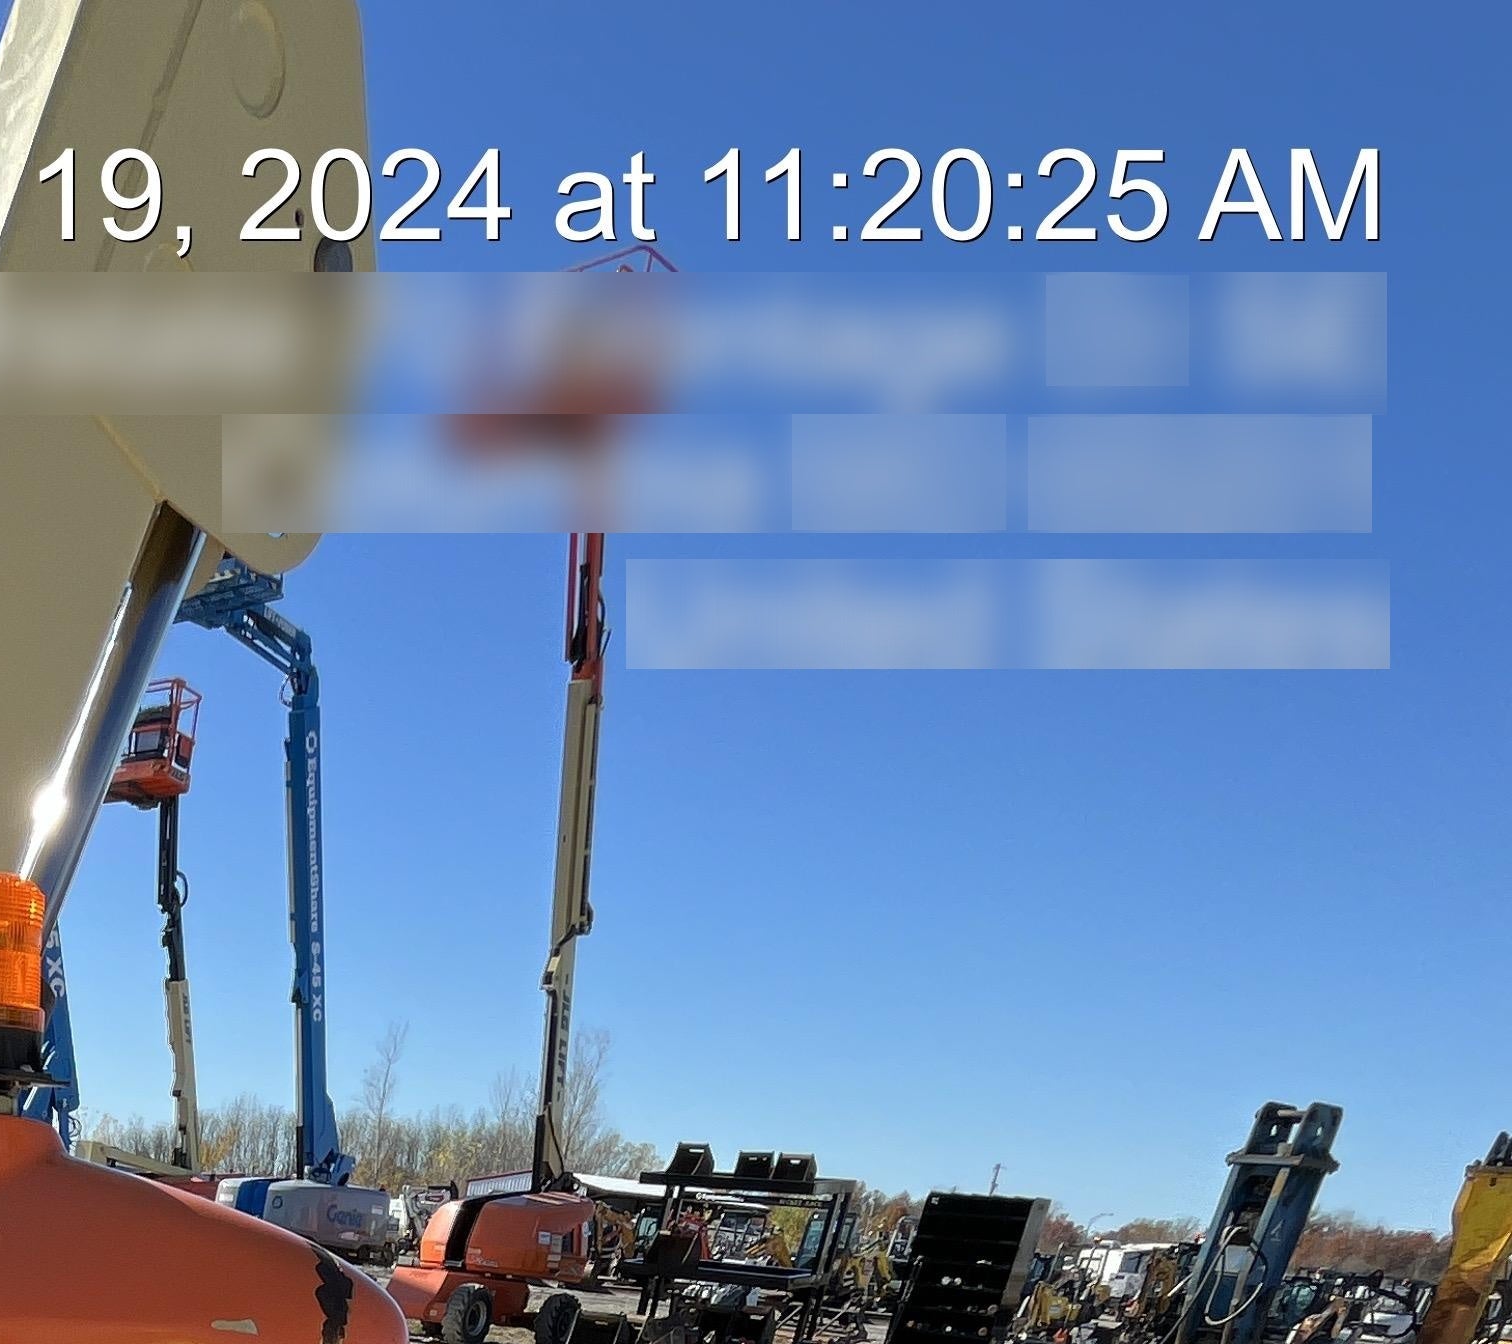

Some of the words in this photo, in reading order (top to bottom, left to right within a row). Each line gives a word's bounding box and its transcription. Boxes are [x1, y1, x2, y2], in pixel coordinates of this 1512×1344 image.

[305, 757, 320, 934] EquipmentShare
[46, 956, 65, 998] XC
[312, 992, 322, 1023] XC
[560, 989, 571, 1030] JLG
[556, 1039, 568, 1088] LIFT
